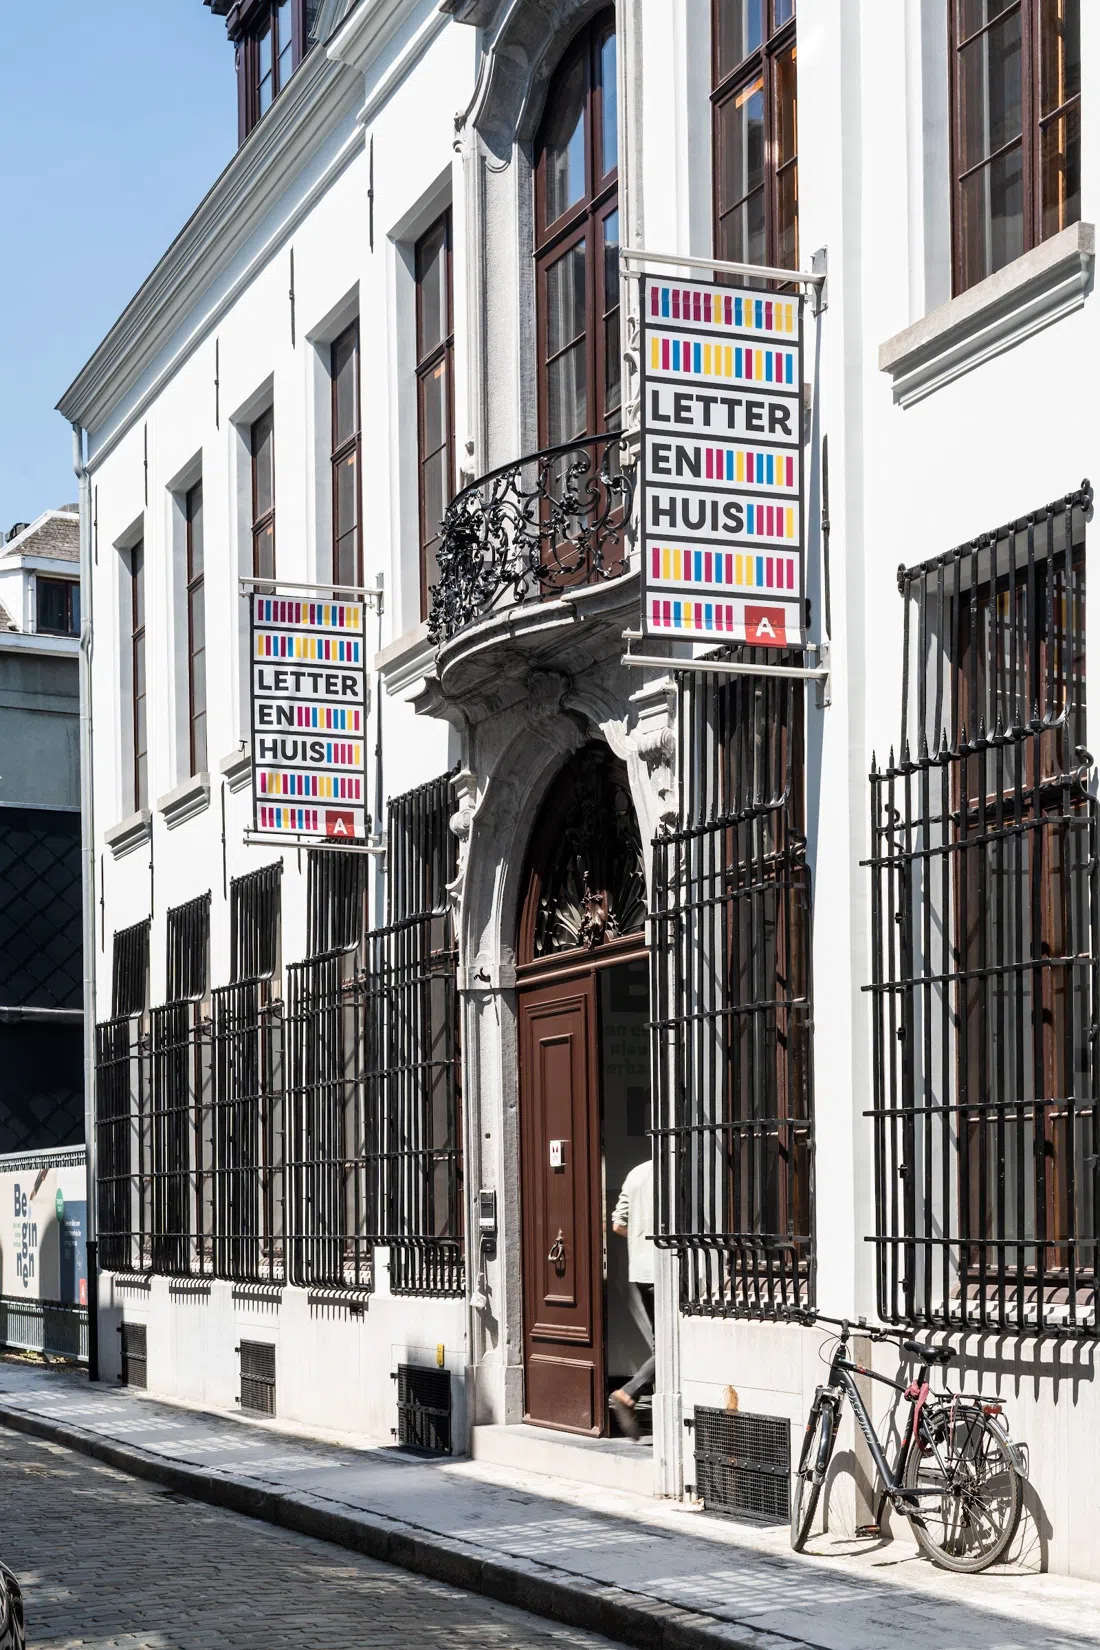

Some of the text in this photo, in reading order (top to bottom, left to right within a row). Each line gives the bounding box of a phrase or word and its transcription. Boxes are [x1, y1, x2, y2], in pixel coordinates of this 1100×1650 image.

[651, 389, 792, 436] LETTER
[651, 442, 701, 479] EN
[651, 495, 745, 534] HUIS
[755, 617, 776, 638] A
[257, 669, 359, 697] LETTER
[258, 704, 295, 727] EN
[259, 738, 325, 763] HUIS
[333, 818, 348, 835] A
